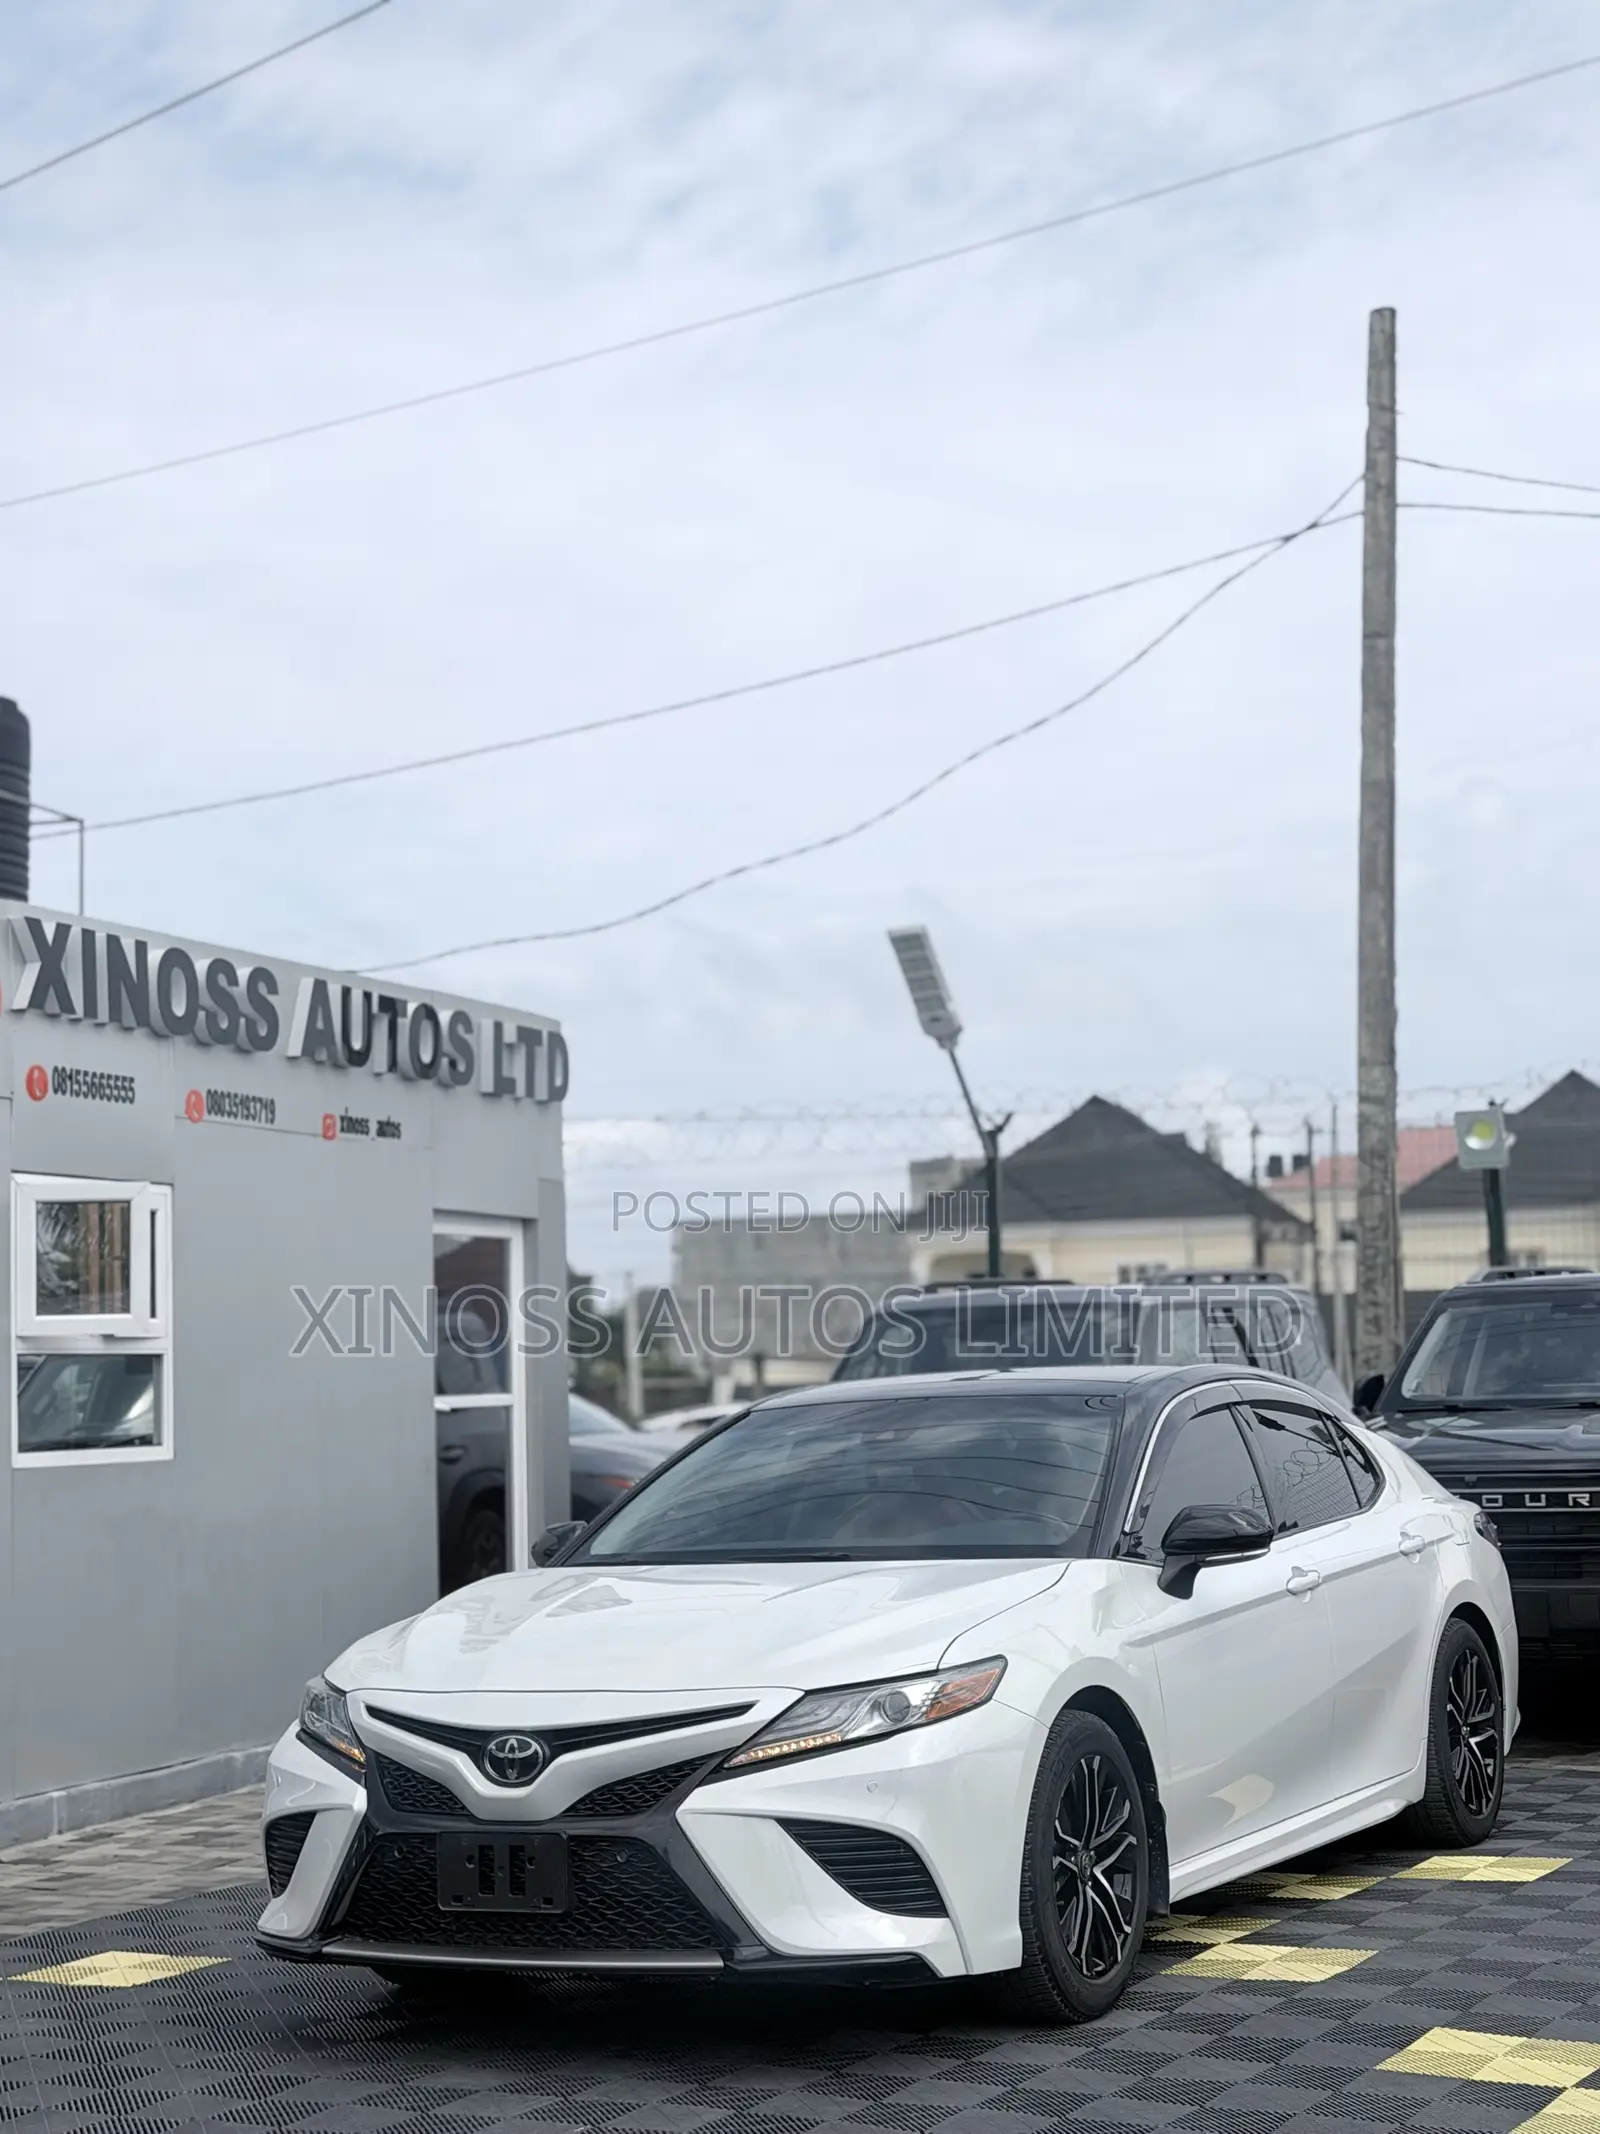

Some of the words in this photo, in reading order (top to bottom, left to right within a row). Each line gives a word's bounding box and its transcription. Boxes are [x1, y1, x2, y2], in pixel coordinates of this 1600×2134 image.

[10, 916, 279, 1052] XINOSS
[287, 978, 475, 1086] AUTOS
[481, 1018, 569, 1102] LTD
[52, 1065, 135, 1105] 08155665555
[1456, 1493, 1591, 1508] OUR
